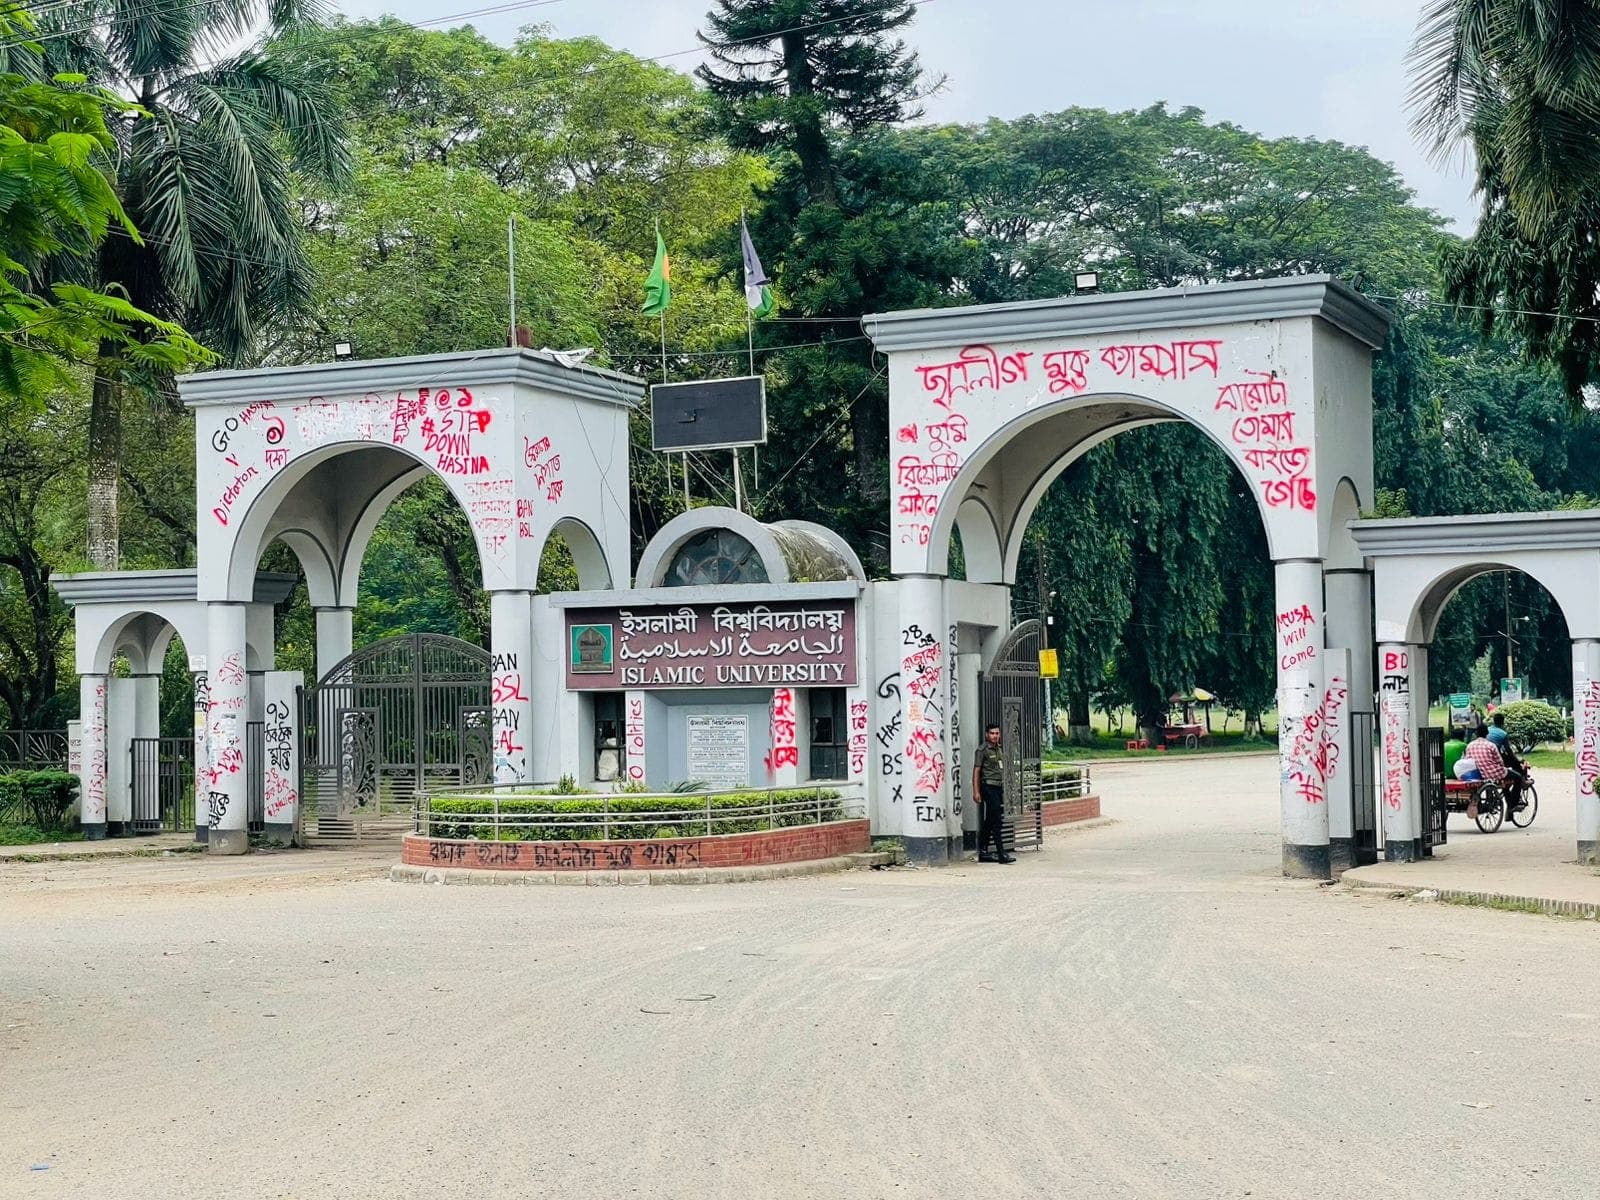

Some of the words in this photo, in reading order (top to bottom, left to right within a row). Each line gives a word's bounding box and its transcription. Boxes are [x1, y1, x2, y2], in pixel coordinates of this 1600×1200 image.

[440, 409, 491, 433] STEP
[1232, 411, 1296, 444] তোমার
[424, 432, 470, 456] DOWN
[437, 453, 490, 475] HASINA
[619, 607, 698, 636] ইসলামী
[711, 605, 845, 632] বিশ্ববিদ্যালয়
[1277, 605, 1315, 632] MUSA
[739, 632, 844, 660] الجامعة
[620, 666, 705, 685] ISLAMIC
[716, 663, 846, 683] UNIVERSITY
